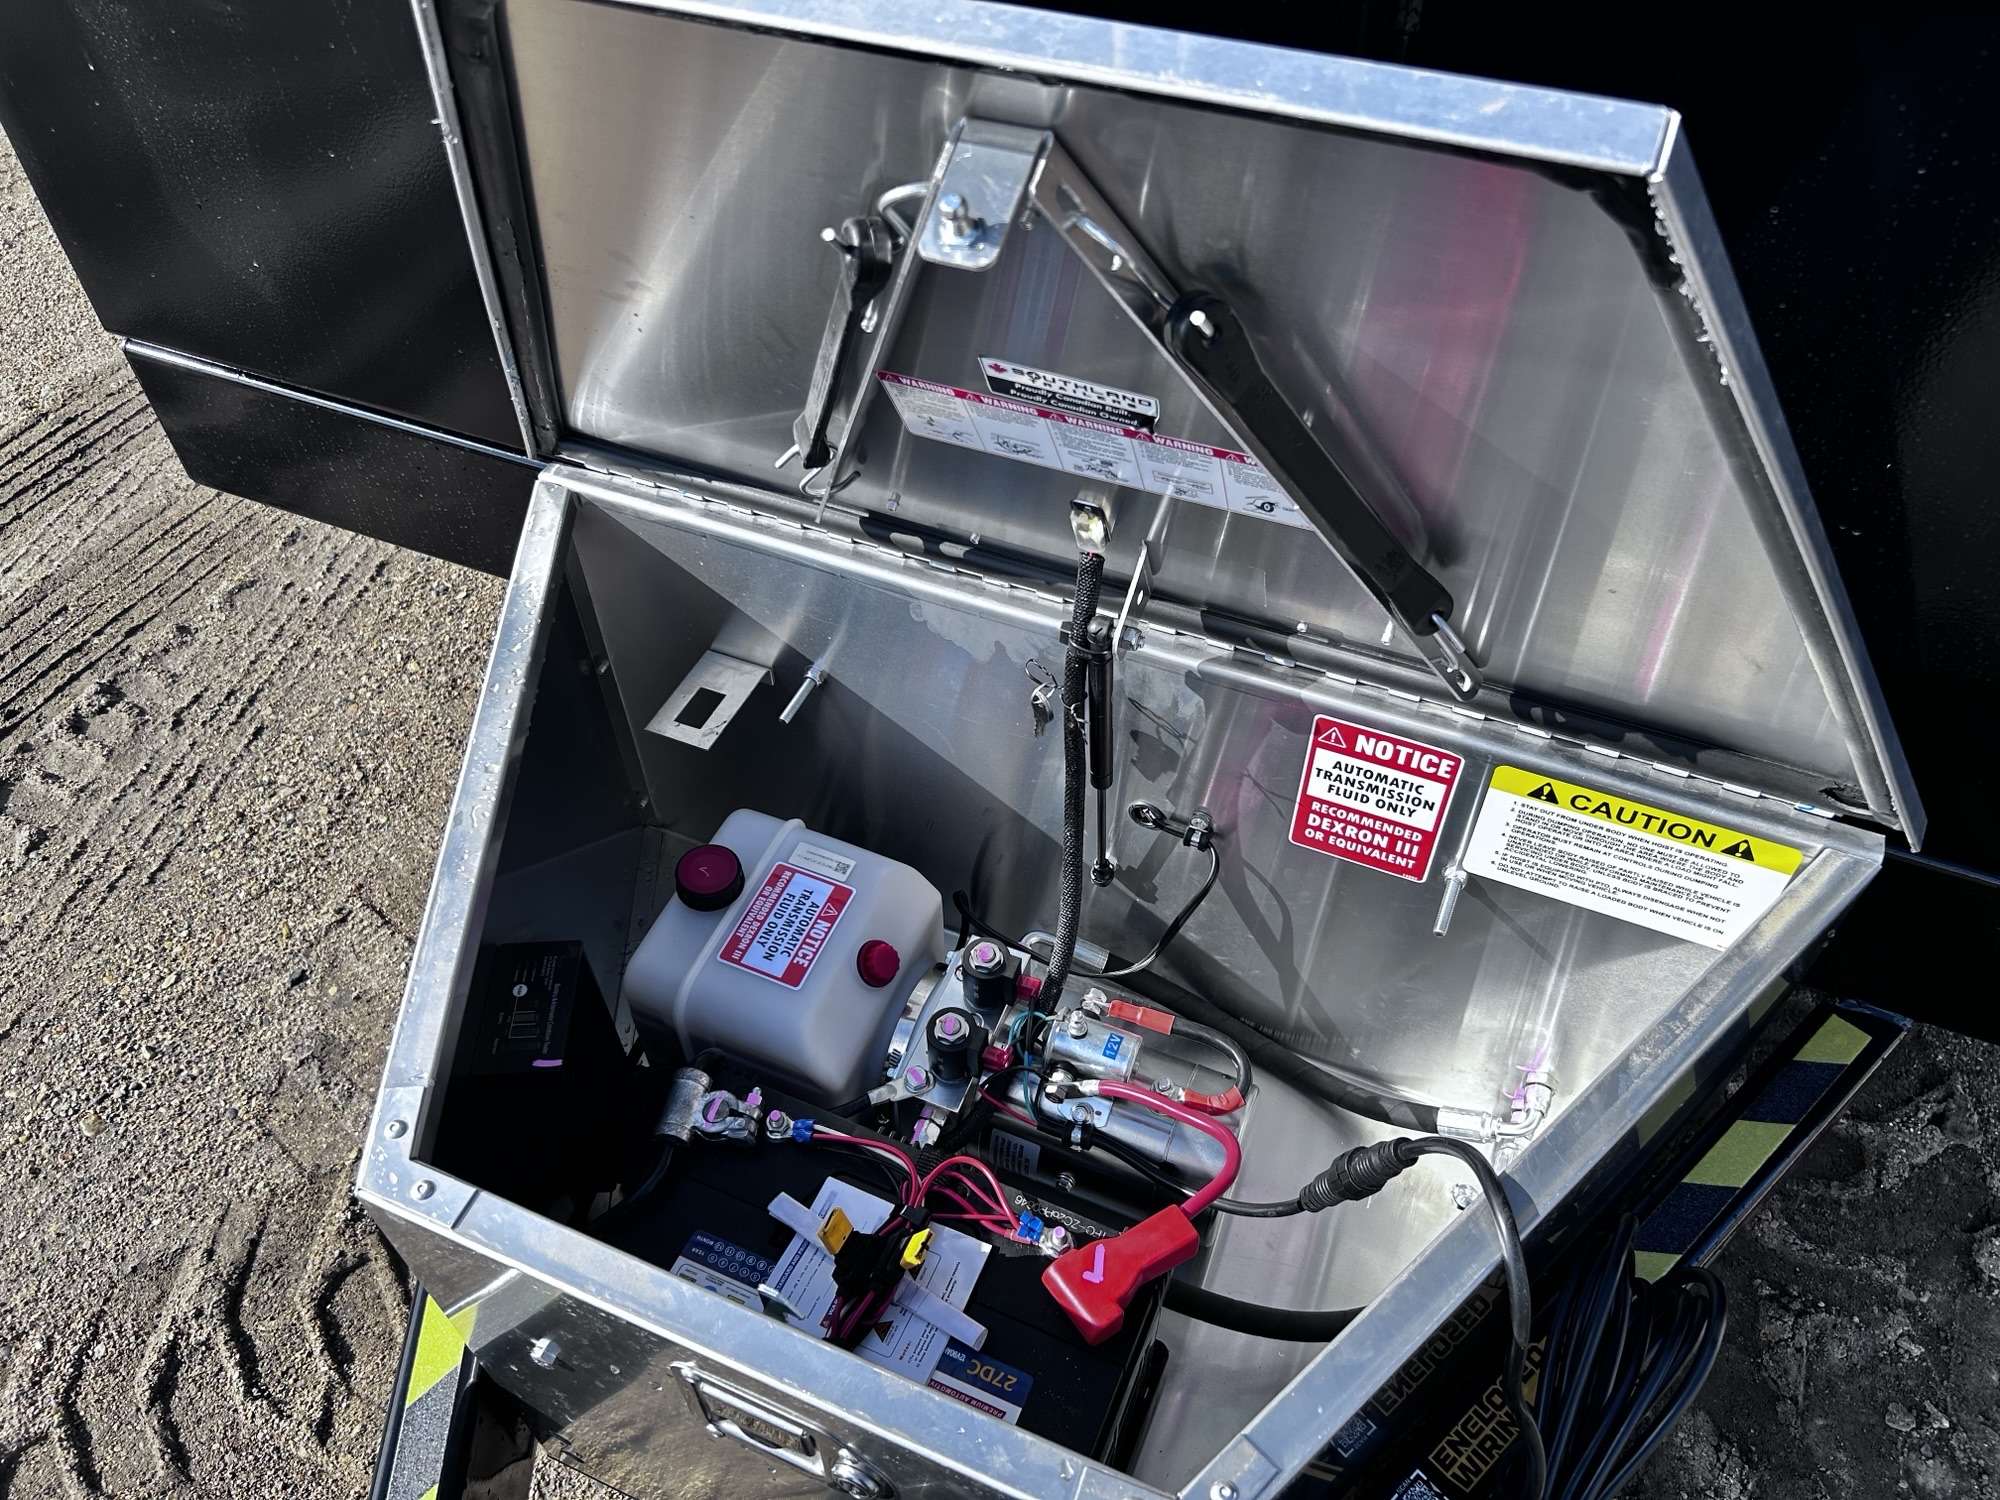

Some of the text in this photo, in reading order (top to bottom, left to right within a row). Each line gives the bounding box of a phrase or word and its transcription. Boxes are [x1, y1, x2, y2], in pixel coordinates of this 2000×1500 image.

[899, 376, 955, 396] WARNING
[980, 396, 1039, 416] WARNING
[1009, 389, 1048, 405] Proudly
[1050, 399, 1097, 416] Canadian
[1011, 367, 1153, 407] SOUTHLAND
[1014, 383, 1051, 398] Proudly
[1055, 393, 1102, 410] Canadian
[1064, 416, 1124, 436] WARNING
[1152, 435, 1215, 456] WARNING
[1332, 761, 1425, 795] AUTOMATIC
[1355, 734, 1455, 779] NOTICE
[1315, 767, 1435, 811] TRANSMISSION
[1327, 784, 1417, 818] FLUID ONLY
[1307, 813, 1419, 858] DEXRON III
[1311, 801, 1422, 842] RECOMMENDED
[1517, 809, 1545, 821] DURING
[1547, 818, 1580, 831] DUMPING
[1639, 845, 1655, 853] ONE
[1656, 850, 1677, 860] MUST
[1690, 860, 1728, 875] ALLOWED
[1520, 802, 1538, 811] STAY
[1539, 808, 1554, 816] OUT
[1556, 813, 1577, 823] FROM
[1578, 819, 1603, 830] UNDER
[1605, 827, 1626, 837] BODY
[1627, 834, 1649, 844] WHEN
[1651, 841, 1674, 851] HOIST
[1569, 794, 1717, 848] CAUTION
[1304, 829, 1416, 869] OR EQUIVALENT
[1503, 846, 1547, 862] ACCIDENTAL
[1506, 838, 1554, 855] UNATTENDED
[1590, 863, 1638, 881] PERFORMING
[1639, 877, 1691, 897] MAINTENANCE
[1508, 834, 1532, 845] NEVER
[1533, 841, 1557, 852] LEAVE
[1557, 848, 1578, 858] BODY
[1578, 855, 1605, 867] RAISED
[1617, 866, 1645, 879] PARTLY
[1646, 875, 1674, 887] RAISED
[1699, 892, 1731, 905] VEHICLE
[1512, 823, 1551, 839] OPERATOR
[1552, 835, 1572, 845] MUST
[1573, 842, 1601, 854] REMAIN
[1612, 854, 1653, 869] CONTROLS
[1654, 866, 1682, 878] DURING
[1683, 875, 1718, 889] DUMPING
[1514, 817, 1536, 827] HOIST
[1537, 824, 1570, 837] OPERATE
[1584, 838, 1601, 847] INTO
[1614, 847, 1635, 857] AREA
[1635, 853, 1662, 865] WHERE
[1670, 863, 1691, 873] LOAD
[1692, 870, 1716, 881] MIGHT
[1516, 813, 1540, 824] STAND
[1562, 826, 1583, 837] MOVE
[1584, 833, 1621, 848] THROUGH
[1622, 844, 1636, 852] THE
[1638, 849, 1658, 859] AREA
[1659, 855, 1686, 867] WHERE
[1688, 864, 1703, 872] THE
[1704, 869, 1725, 879] BODY
[1727, 876, 1743, 884] AND
[1496, 866, 1527, 878] UNLEVEL
[1508, 858, 1522, 866] USE
[1536, 867, 1557, 877] WHEN
[1558, 873, 1586, 885] MOVING
[1509, 854, 1530, 864] HOIST
[1539, 863, 1575, 878] EQUIPPED
[1576, 874, 1594, 883] WITH
[1612, 886, 1641, 898] ALWAYS
[1642, 895, 1685, 912] DISENGAGE
[1686, 908, 1708, 919] WHEN
[1544, 853, 1568, 865] UNDER
[1621, 877, 1643, 887] BODY
[1652, 886, 1683, 899] BRACED
[1695, 899, 1730, 913] PREVENT
[736, 886, 773, 937] OR EQUIVALENT
[757, 870, 793, 922] RECOMMENDED
[1509, 865, 1524, 873] NOT
[1525, 870, 1556, 883] ATTEMPT
[1568, 883, 1590, 893] RAISE
[1597, 892, 1626, 905] LOADED
[1627, 901, 1647, 911] BODY
[1648, 908, 1671, 918] WHEN
[1671, 915, 1702, 928] VEHICLE
[1712, 927, 1724, 935] ON
[738, 922, 761, 949] DEXRON
[757, 892, 792, 949] FLUID ONLY
[762, 888, 814, 961] TRANSMISSION
[780, 901, 820, 958] AUTOMATIC
[793, 919, 832, 968] NOTICE
[1105, 1034, 1121, 1056] 12V
[691, 1247, 705, 1256] YEAR
[966, 1359, 1018, 1392] 27DC
[970, 1399, 1005, 1419] PREMIUM
